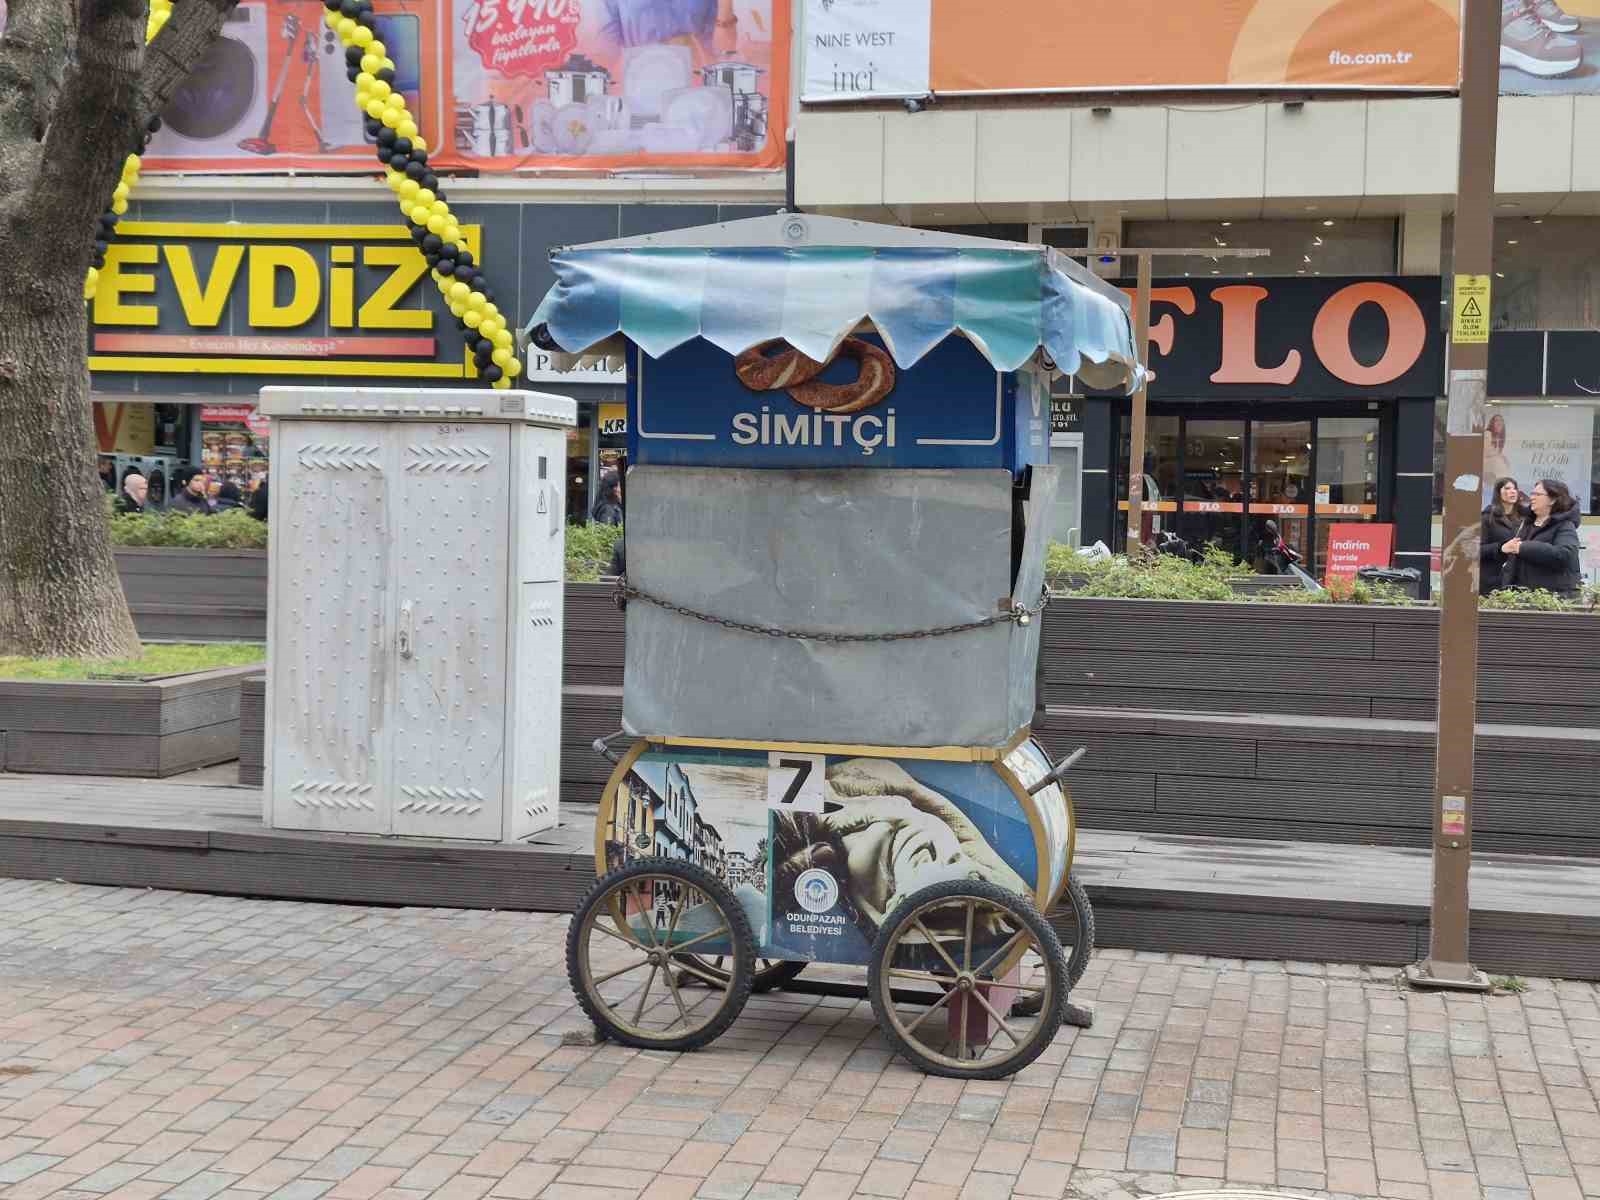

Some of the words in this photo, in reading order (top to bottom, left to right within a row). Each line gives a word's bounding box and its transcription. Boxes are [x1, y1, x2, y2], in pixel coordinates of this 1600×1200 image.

[815, 32, 852, 48] NINE
[855, 31, 896, 47] WEST
[1328, 50, 1413, 66] flo.com.tr
[731, 407, 896, 455] SİMİTÇİ
[1199, 502, 1221, 511] FLO
[1271, 504, 1295, 514] FLO
[1335, 504, 1359, 514] FLO
[1332, 539, 1370, 551] indirim
[779, 758, 813, 804] 7
[786, 912, 846, 925] ODUNPAZARI
[790, 923, 842, 936] BELEDİYESİ
